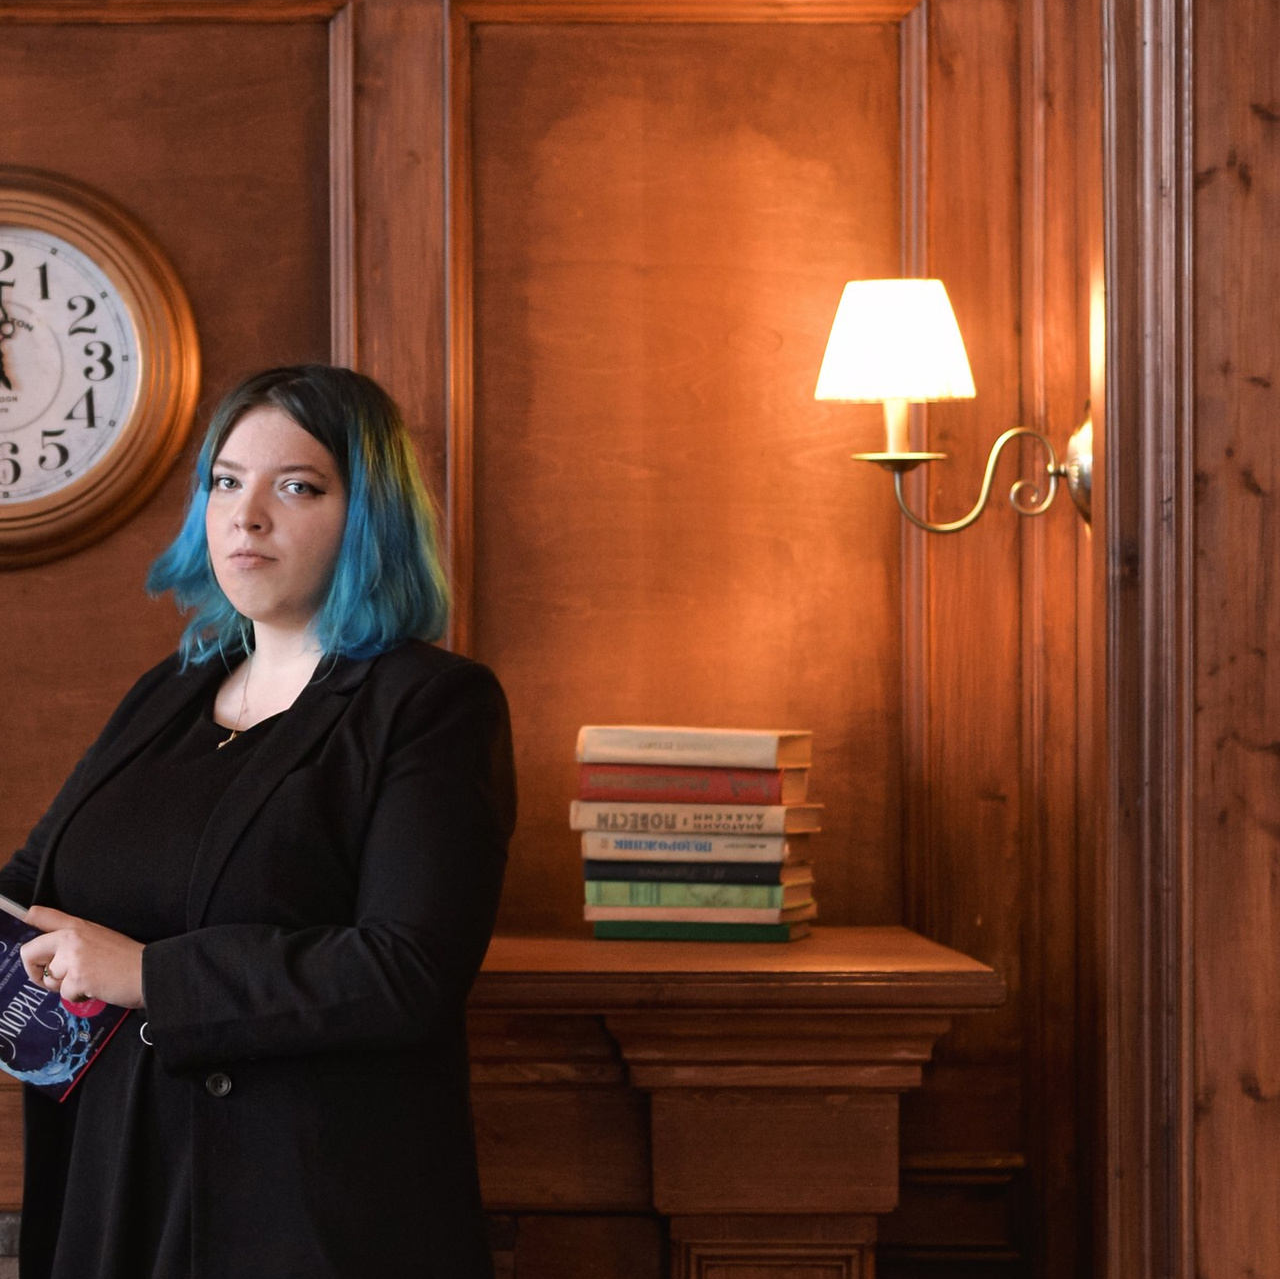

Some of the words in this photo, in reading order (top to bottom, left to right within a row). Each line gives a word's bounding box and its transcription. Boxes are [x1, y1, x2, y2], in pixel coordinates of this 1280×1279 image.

[36, 262, 51, 301] 1
[67, 295, 97, 336] 2
[83, 341, 114, 381] 3
[64, 386, 103, 429] 4
[39, 429, 69, 471] 5
[597, 811, 676, 829] ПОВЕСТИ
[693, 822, 763, 831] АНАТОЛИЙ
